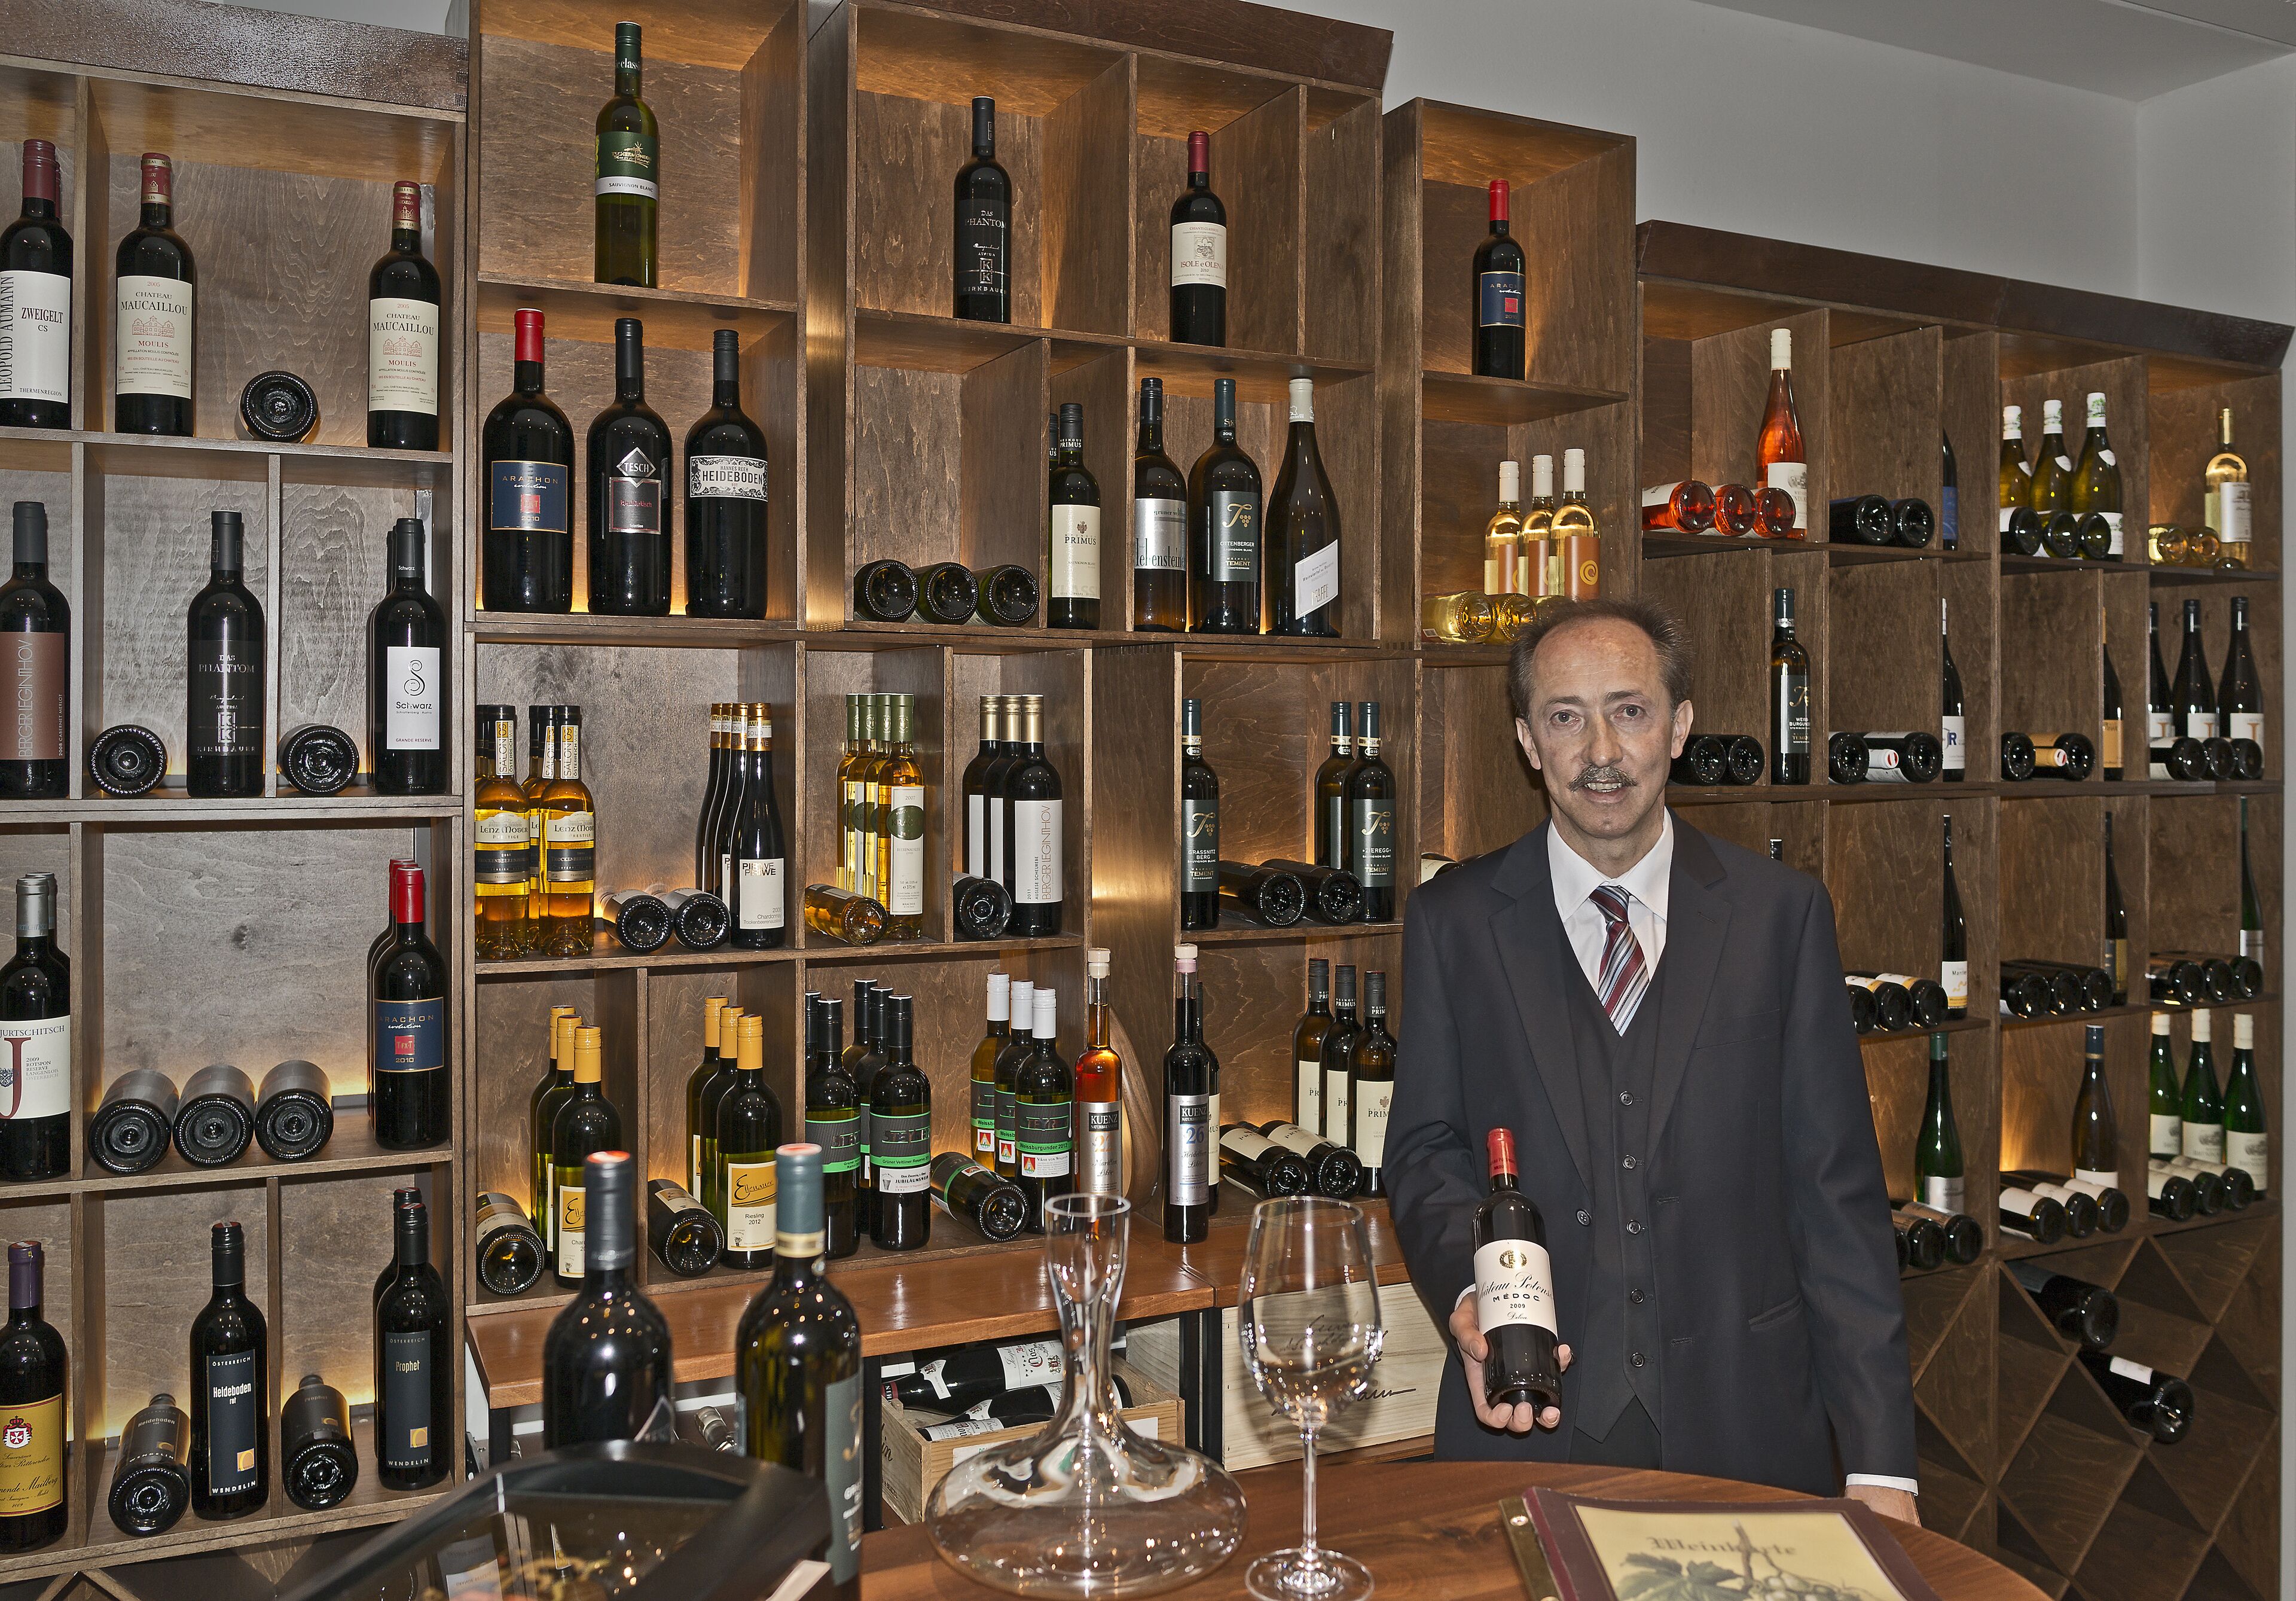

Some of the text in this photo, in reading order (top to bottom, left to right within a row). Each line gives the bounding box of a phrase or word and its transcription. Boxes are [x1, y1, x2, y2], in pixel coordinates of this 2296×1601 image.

[1205, 261, 1224, 270] OLENA
[121, 301, 187, 315] MAUCAILLOU
[22, 307, 63, 324] ZWEIGELT
[0, 277, 14, 392] LEOPOLD AUMANN
[373, 322, 434, 336] MAUCAILLOU
[20, 388, 62, 397] THERMENREGION
[624, 463, 649, 472] TESCH
[502, 475, 558, 484] ARAHON
[703, 471, 762, 484] HEIDEBODEN
[1065, 536, 1097, 545] PRIMUS
[19, 713, 32, 757] BERGER
[1042, 864, 1051, 899] BERGER
[0, 1025, 65, 1038] JURTSCHITSCH
[1181, 1106, 1207, 1117] KUENZ
[1091, 1114, 1118, 1124] KUENZ
[1186, 1126, 1204, 1144] 26
[1493, 1293, 1540, 1303] MÉDOC
[212, 1356, 251, 1367] ÖSTERREICH
[396, 1360, 420, 1373] Prophet
[213, 1383, 251, 1398] Heideboden
[138, 1417, 175, 1428] Heideboden
[129, 1452, 174, 1462] WENDELIN
[212, 1480, 256, 1494] WENDELIN
